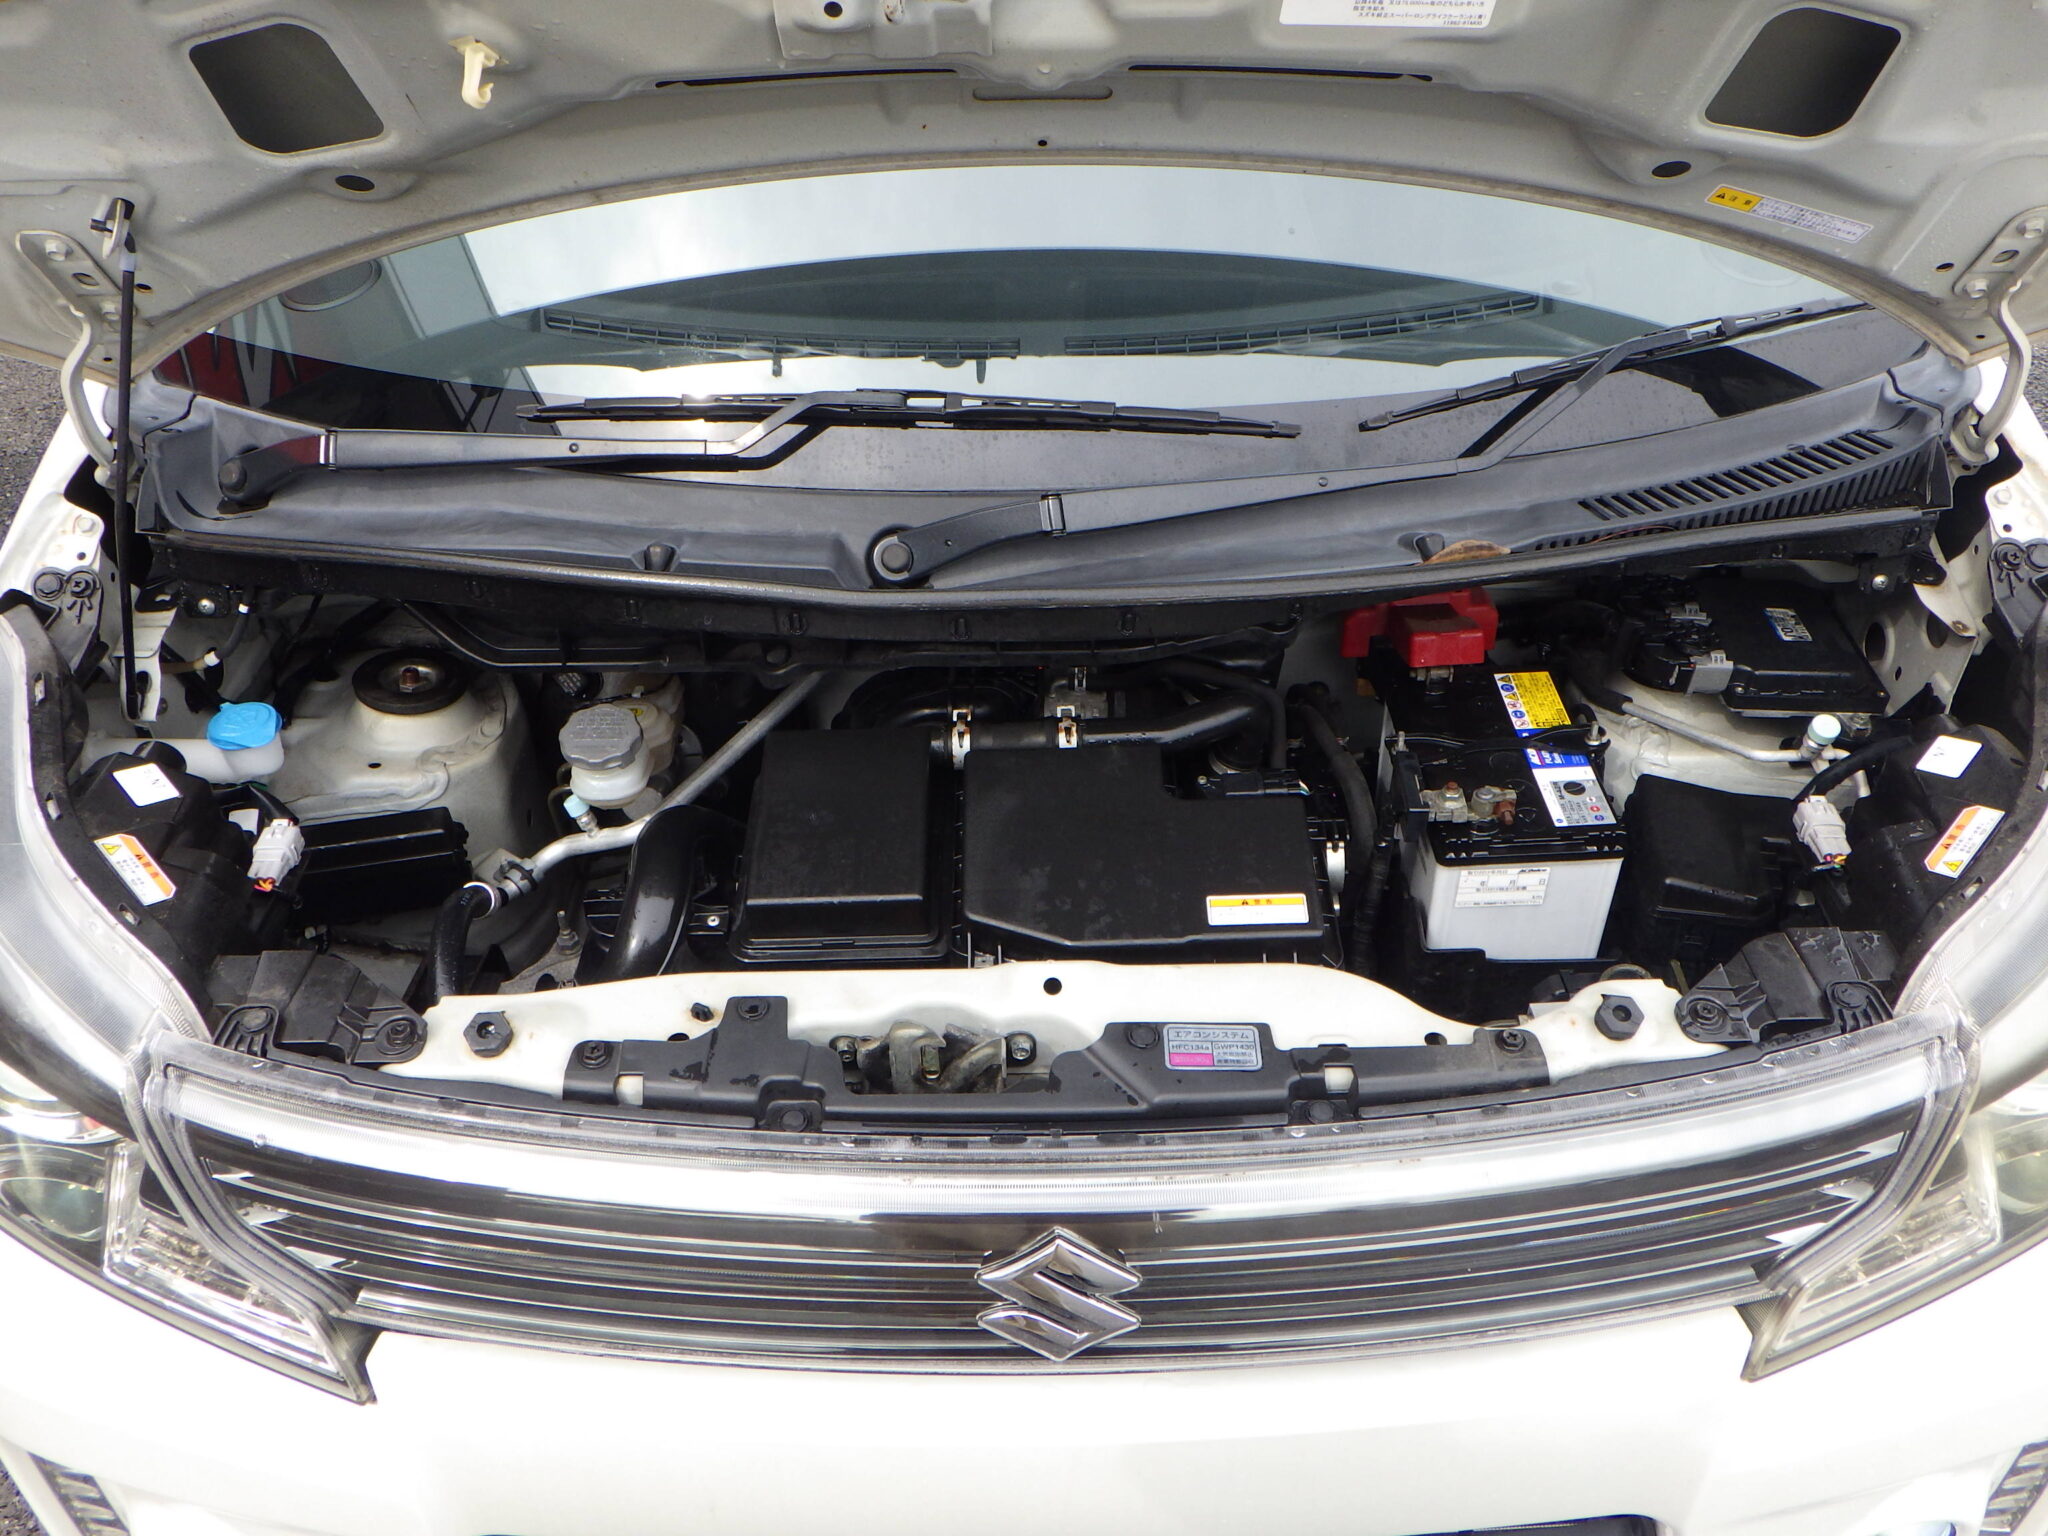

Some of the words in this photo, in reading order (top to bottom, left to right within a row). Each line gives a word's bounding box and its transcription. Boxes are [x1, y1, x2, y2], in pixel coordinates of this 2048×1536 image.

[1174, 1030, 1249, 1039] エアコンシステム
[1171, 1043, 1210, 1051] HFC134a
